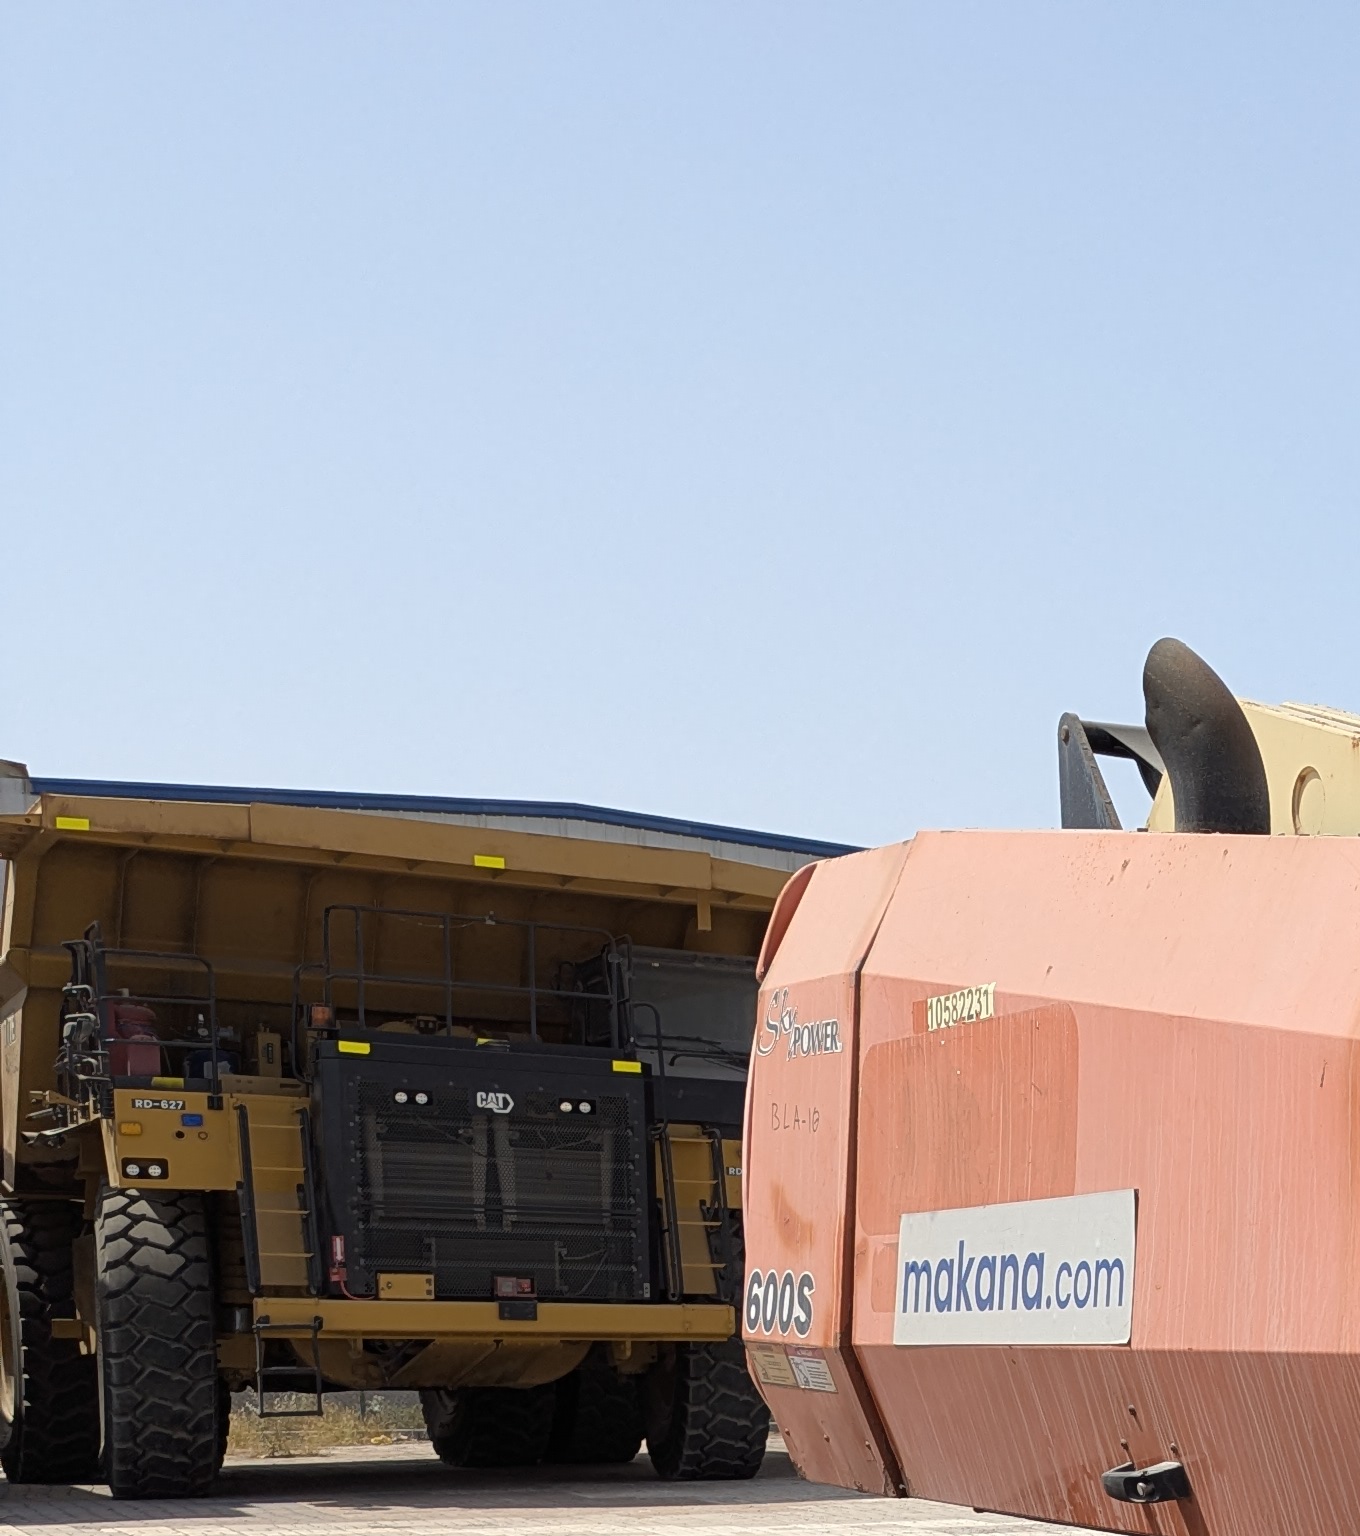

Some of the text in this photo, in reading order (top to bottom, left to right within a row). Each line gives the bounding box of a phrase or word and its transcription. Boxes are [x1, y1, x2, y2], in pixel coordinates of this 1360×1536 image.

[757, 986, 797, 1061] Sky
[928, 988, 990, 1031] 10582231
[792, 1018, 843, 1057] POWER
[134, 1099, 183, 1110] RD-627
[477, 1091, 506, 1109] CAT
[902, 1239, 1125, 1314] makana.com
[745, 1269, 815, 1338] 600S
